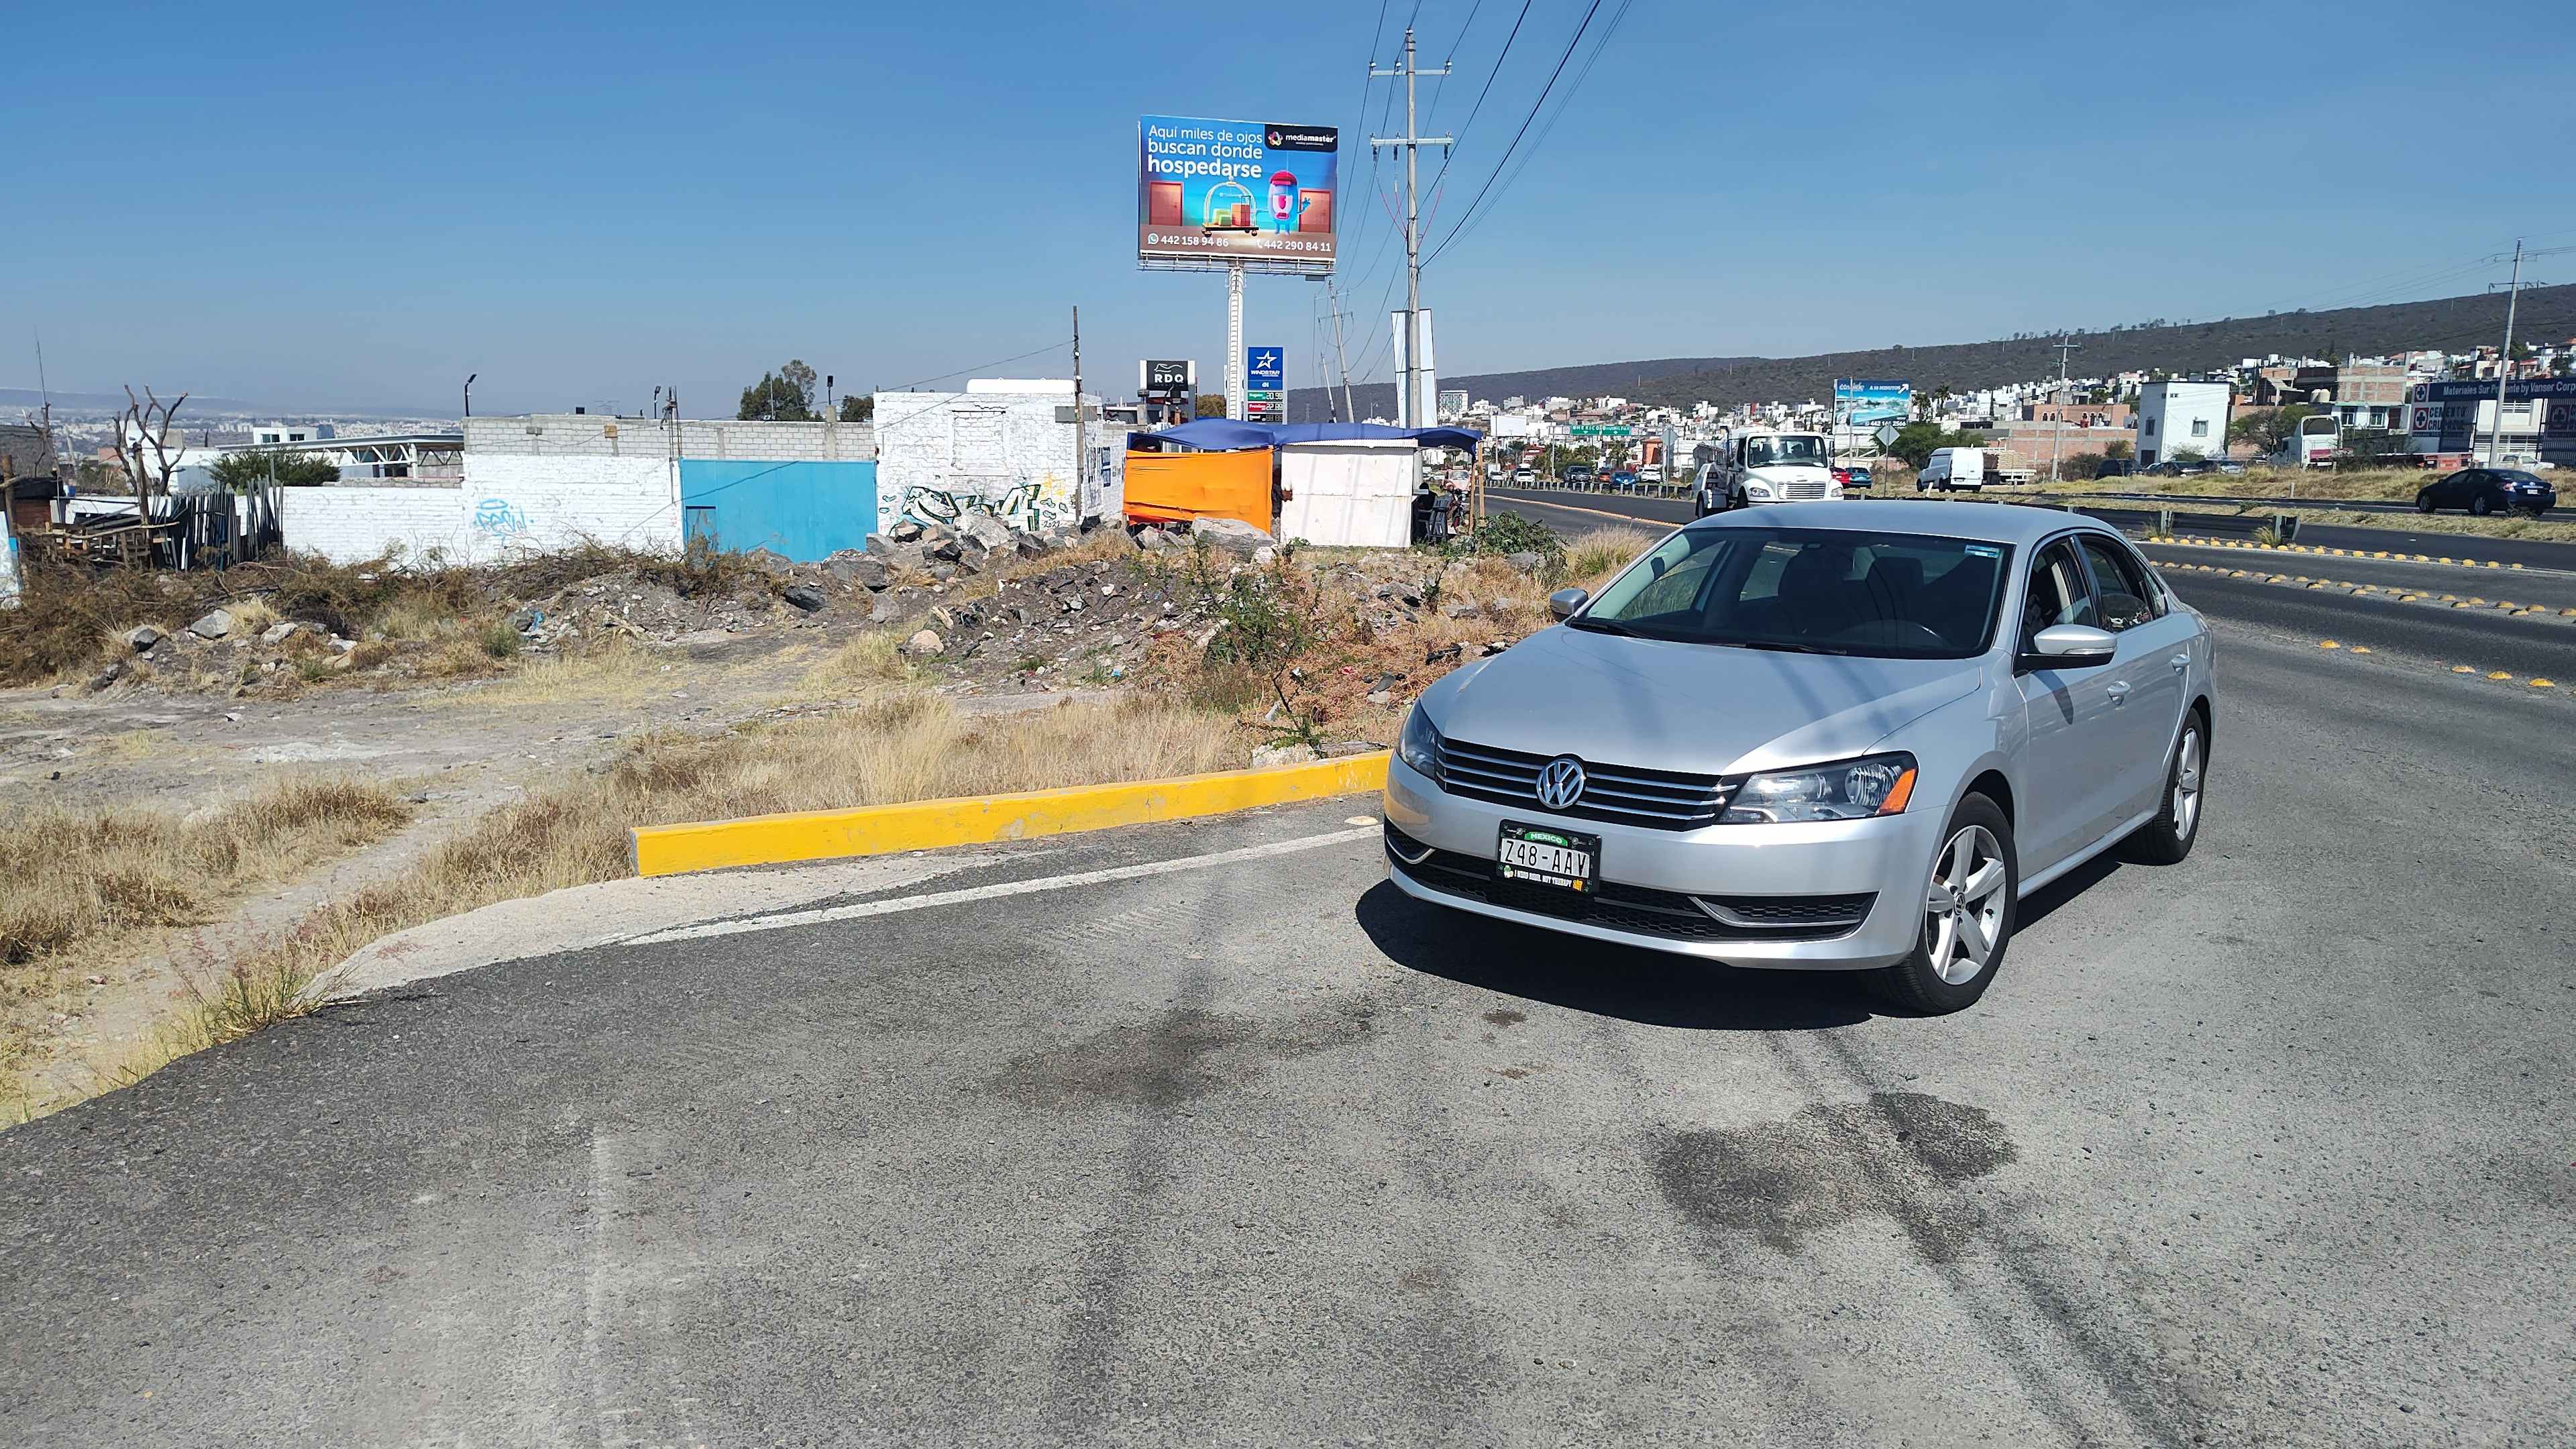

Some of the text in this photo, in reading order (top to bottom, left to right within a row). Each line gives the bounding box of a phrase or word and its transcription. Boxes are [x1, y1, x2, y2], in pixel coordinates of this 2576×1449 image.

[1148, 124, 1263, 146] Aquí miles de ojos
[1285, 133, 1334, 143] mediamaster
[1148, 138, 1263, 159] buscan donde
[1148, 154, 1262, 178] hospedarse
[1161, 235, 1229, 247] 442 158 94 86
[1265, 240, 1332, 252] 442 290 84 11
[1154, 374, 1184, 383] RDQ
[2443, 386, 2477, 396] Materiales
[2478, 384, 2490, 394] Sur
[2491, 384, 2520, 394] Poente
[2521, 384, 2529, 396] by
[2557, 380, 2576, 394] Corp
[1529, 833, 1563, 844] MEXICO
[1504, 840, 1587, 877] Z48-AAV
